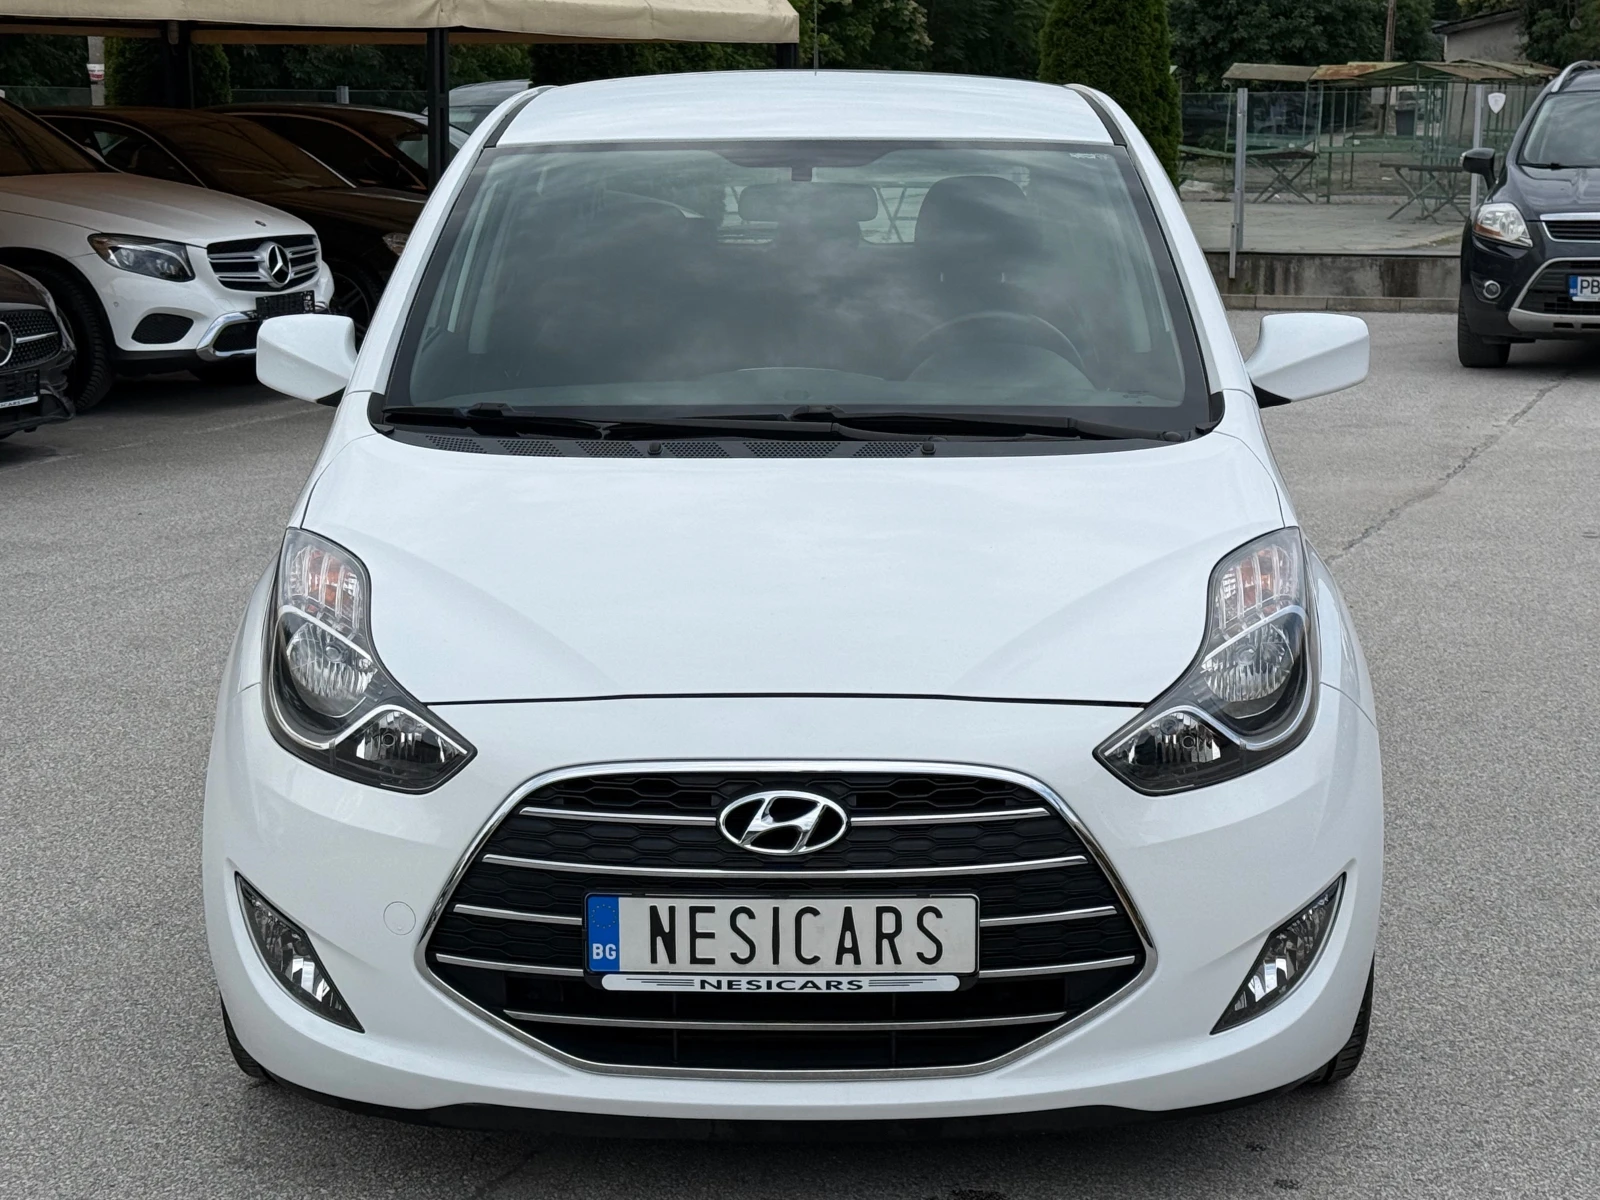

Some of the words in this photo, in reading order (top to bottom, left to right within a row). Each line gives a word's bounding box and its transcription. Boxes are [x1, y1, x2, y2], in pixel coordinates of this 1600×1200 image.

[649, 905, 943, 966] NESICARS
[592, 943, 617, 960] BG
[700, 979, 864, 991] NESICARS
